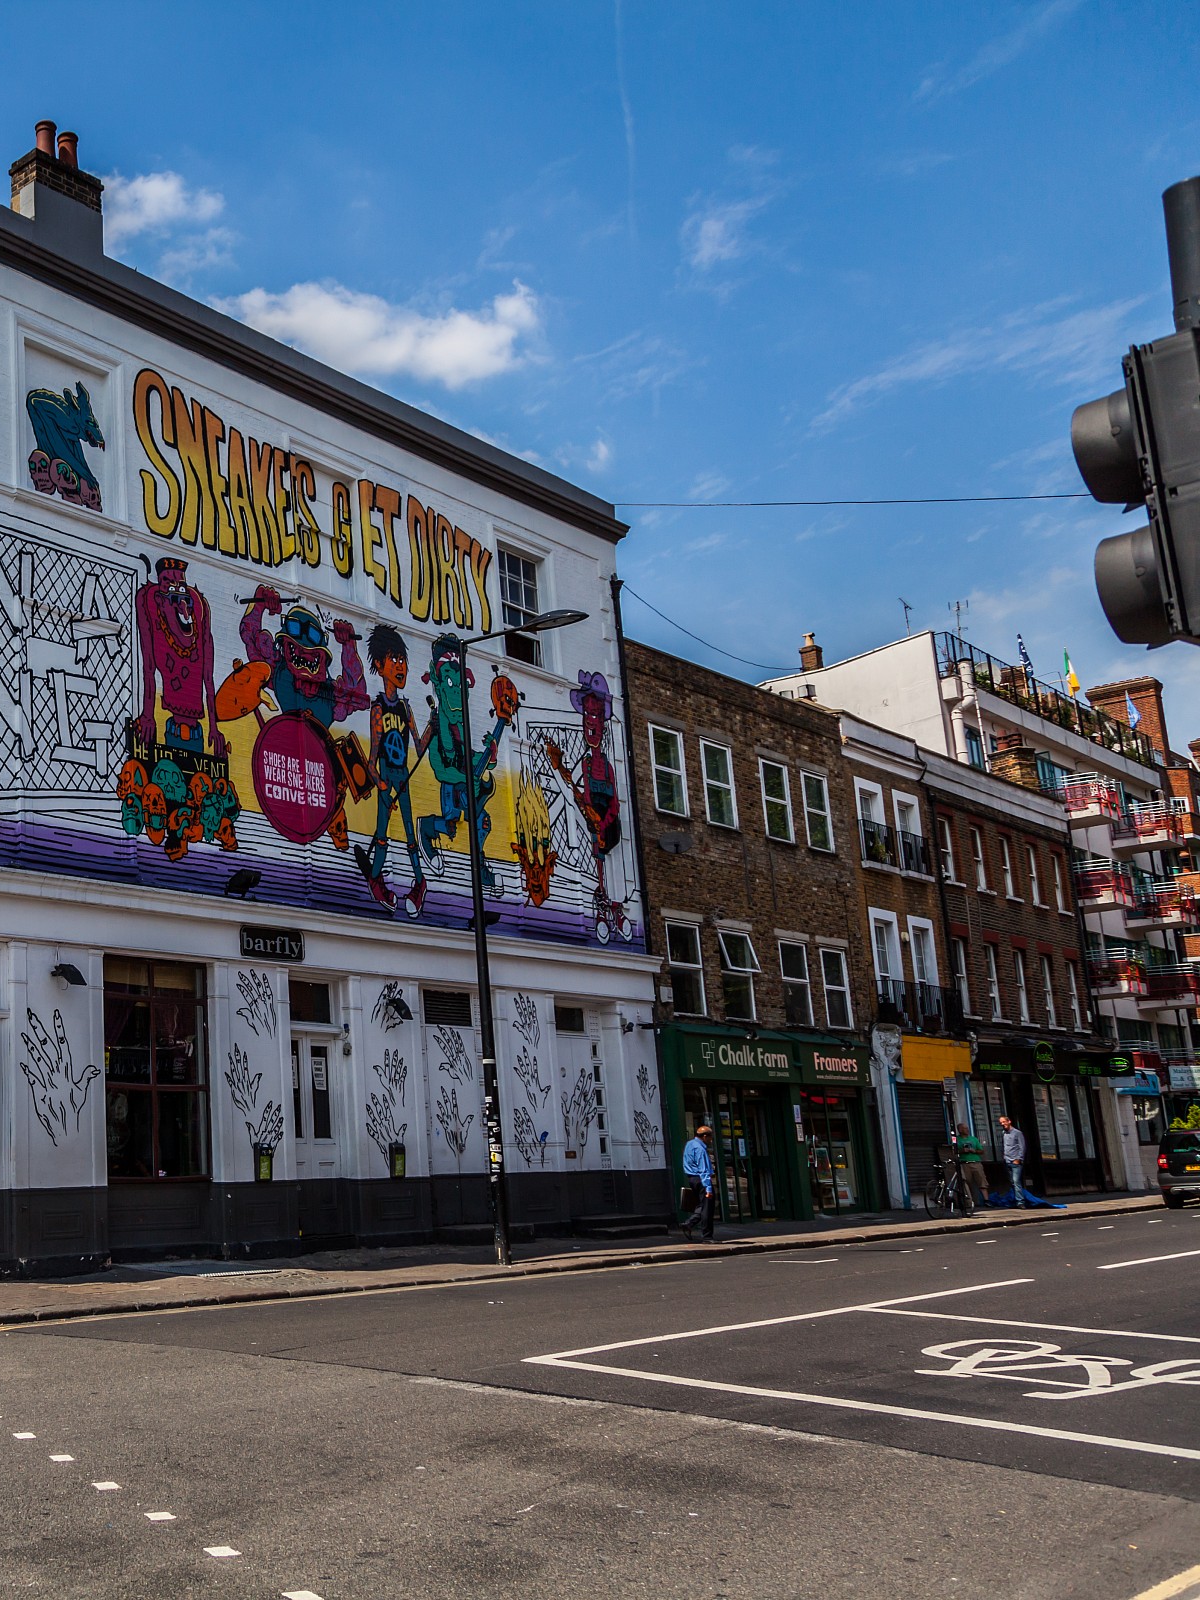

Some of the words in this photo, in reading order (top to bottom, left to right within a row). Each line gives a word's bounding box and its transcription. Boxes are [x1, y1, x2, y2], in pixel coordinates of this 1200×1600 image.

[133, 367, 321, 568] SNEAKERS
[331, 479, 402, 609] GET
[407, 493, 492, 635] DIRTY
[263, 750, 286, 769] SHOES
[287, 756, 300, 773] ARE
[264, 764, 286, 784] WEAR
[287, 771, 326, 793] SNEAKERS
[265, 783, 327, 808] CONVERSE
[242, 932, 301, 958] barfly
[689, 1063, 694, 1074] 1
[718, 1043, 756, 1067] Chalk
[757, 1047, 789, 1069] Farm
[813, 1052, 858, 1073] Framers
[865, 1073, 870, 1083] 3
